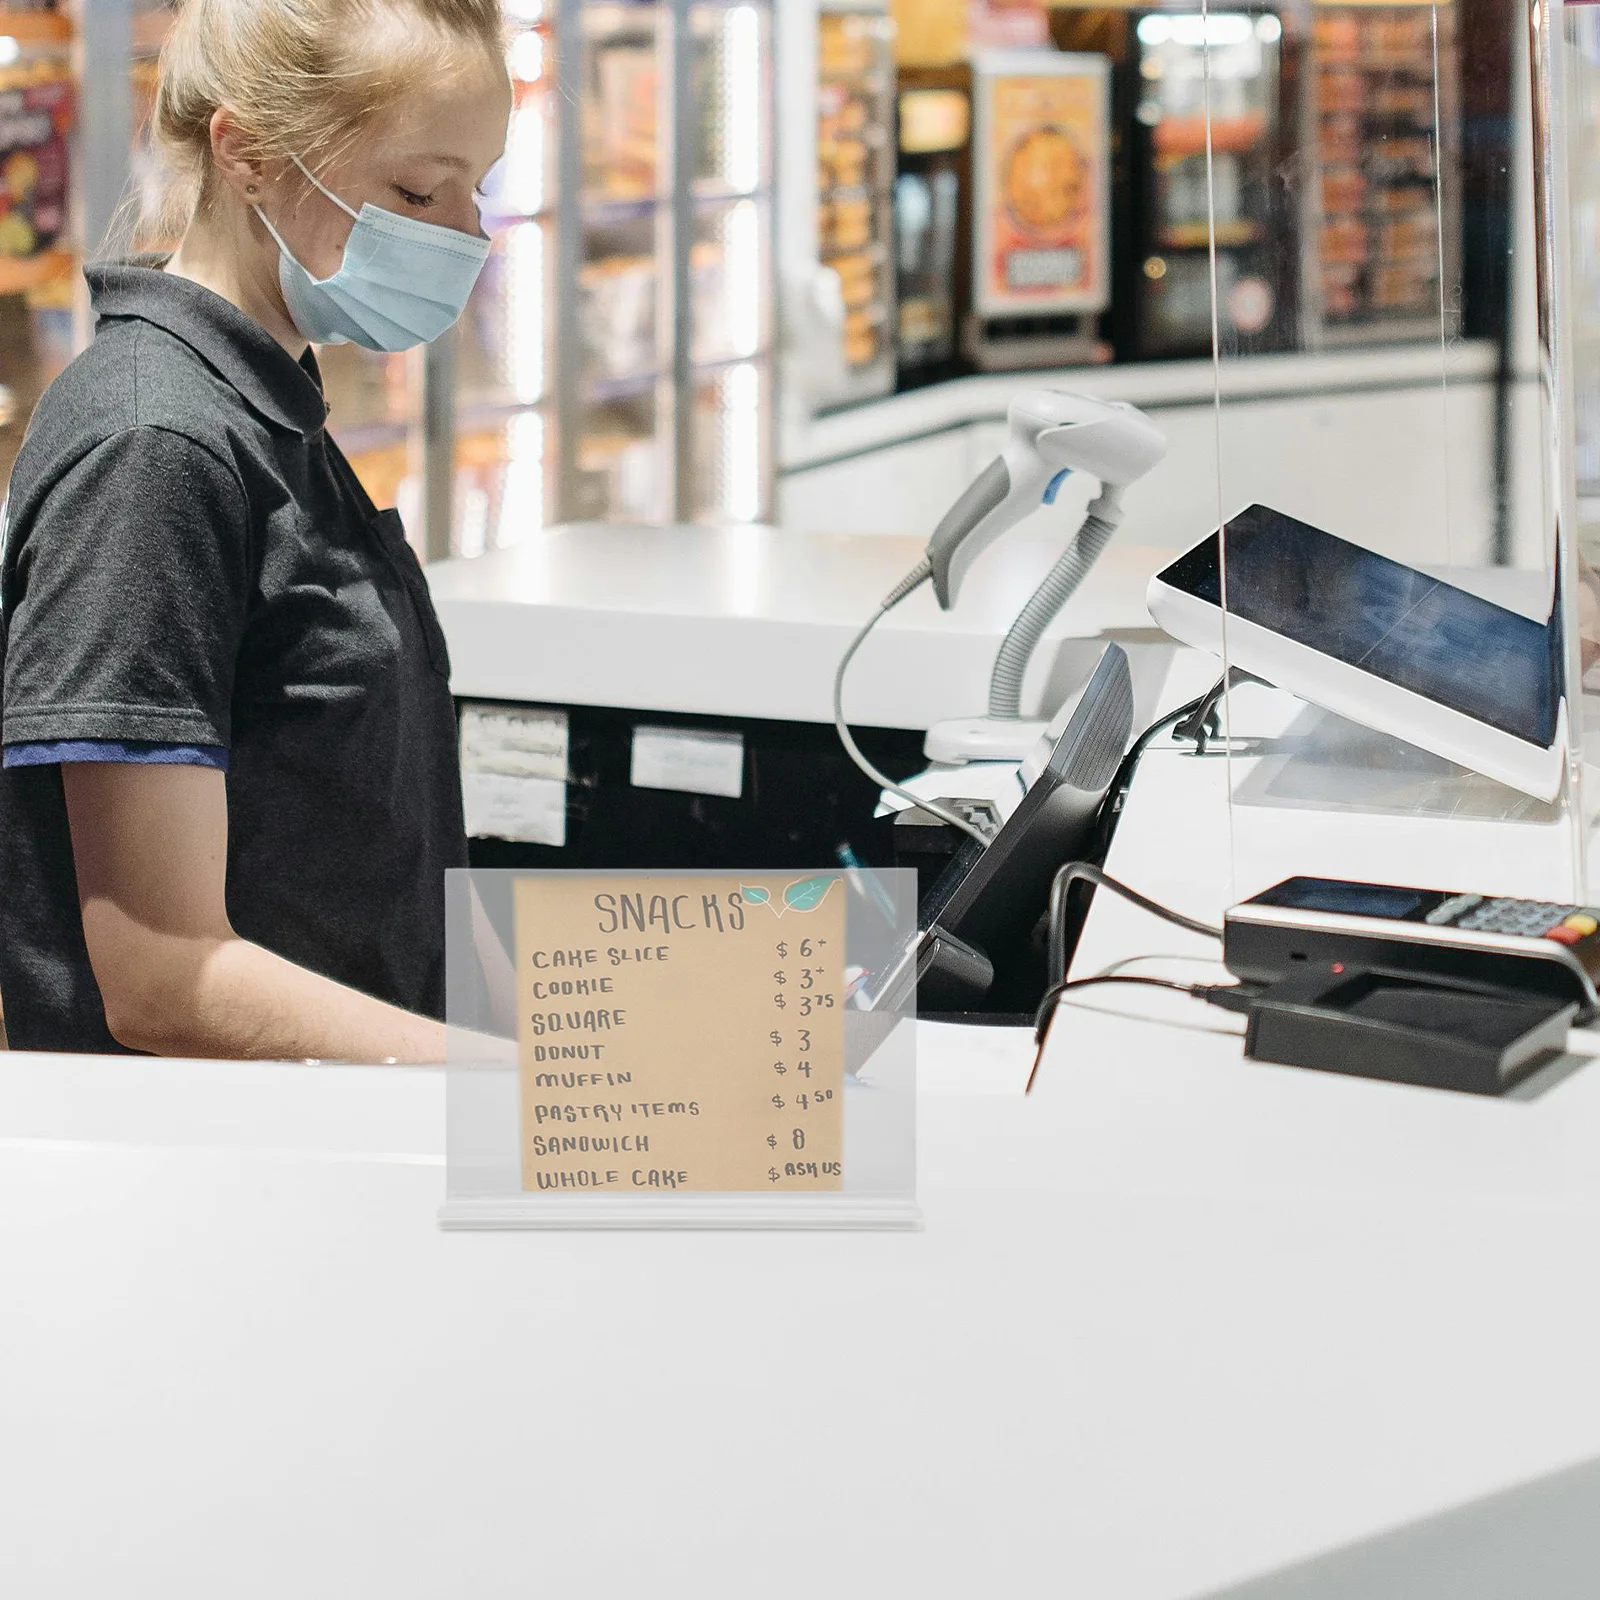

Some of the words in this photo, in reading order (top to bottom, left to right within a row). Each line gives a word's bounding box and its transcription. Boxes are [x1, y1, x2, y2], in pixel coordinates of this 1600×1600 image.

[594, 892, 745, 935] SNACKS
[532, 949, 598, 969] CAKE
[606, 945, 670, 966] SLICE
[532, 977, 614, 1000] COOKIE
[531, 1009, 627, 1036] SQUARE
[534, 1044, 605, 1062] DONUT
[535, 1071, 632, 1089] MUFFIN
[534, 1103, 622, 1125] PASTRY
[631, 1101, 700, 1118] ITEMS
[532, 1135, 649, 1157] SANDWICH
[536, 1169, 619, 1190] WHOLE
[631, 1169, 688, 1189] CAKE
[784, 1161, 819, 1179] ASK
[821, 1161, 842, 1177] US
